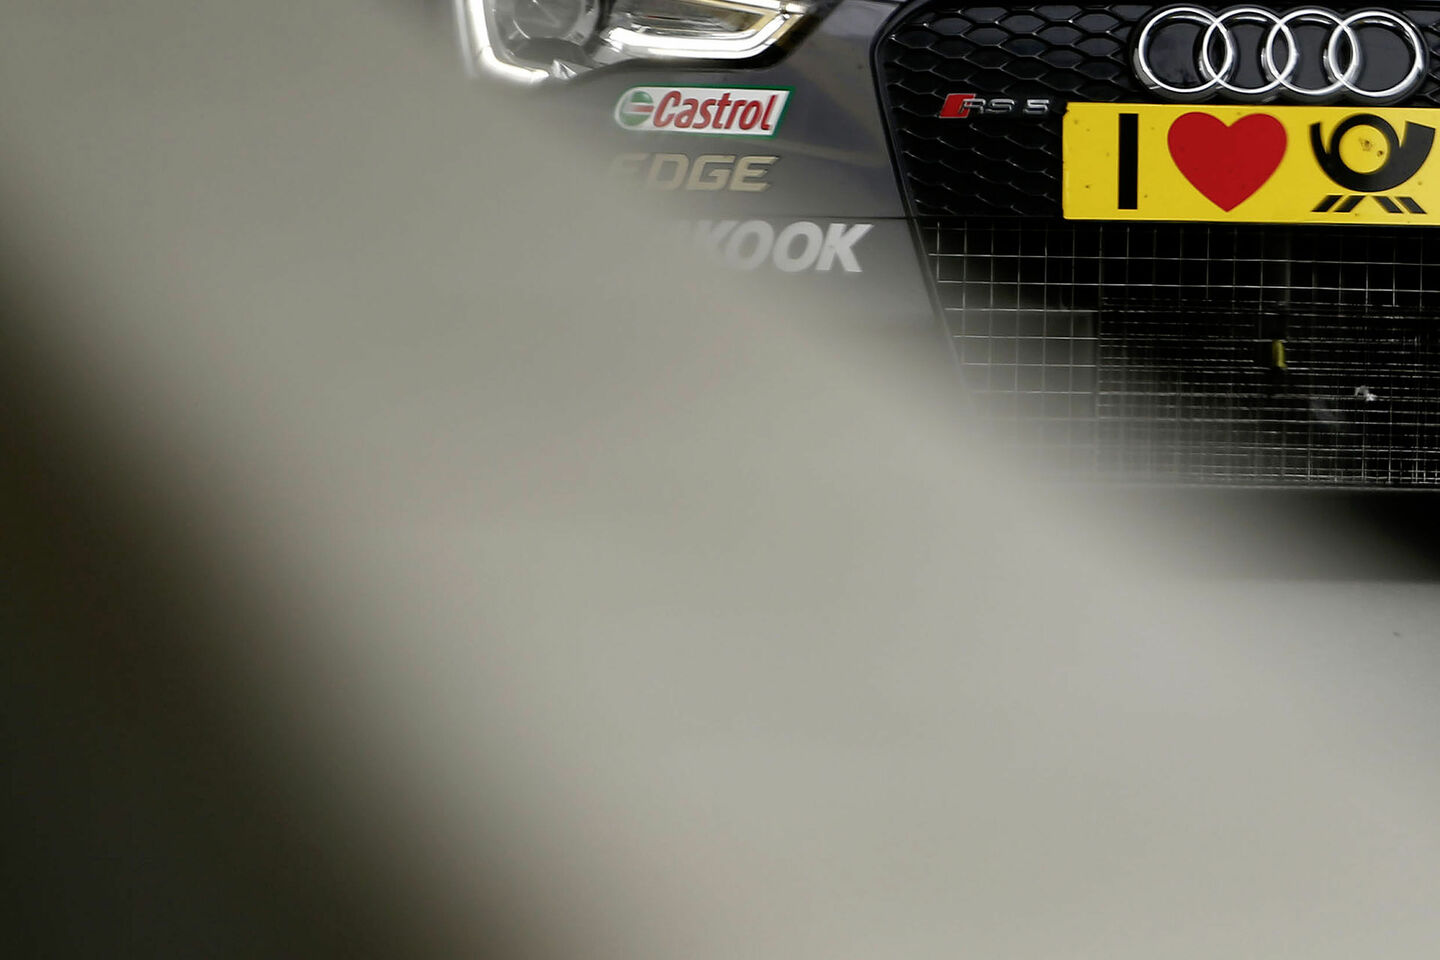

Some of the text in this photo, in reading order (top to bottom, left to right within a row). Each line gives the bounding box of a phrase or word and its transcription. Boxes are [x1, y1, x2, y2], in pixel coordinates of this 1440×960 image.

[652, 90, 779, 132] Castrol
[958, 98, 1050, 115] RS 5
[1118, 113, 1139, 210] I
[680, 220, 874, 273] KOOK
